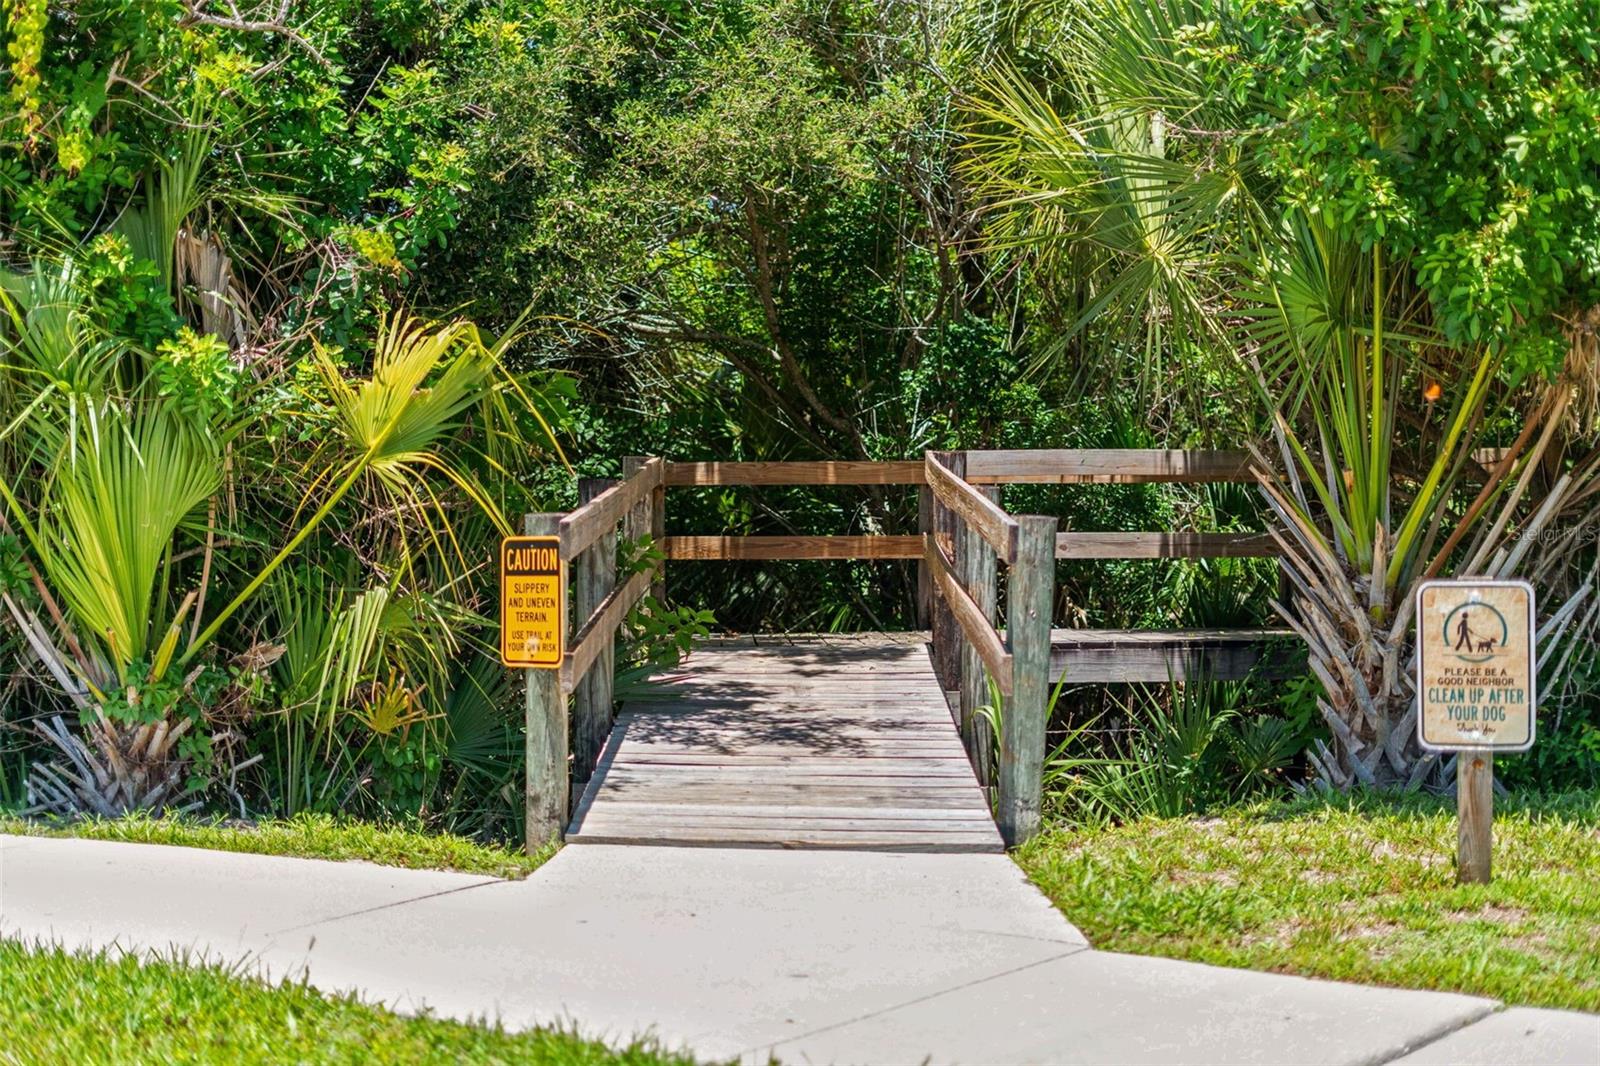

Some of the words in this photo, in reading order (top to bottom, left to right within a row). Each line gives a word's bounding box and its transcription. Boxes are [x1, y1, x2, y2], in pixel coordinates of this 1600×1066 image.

[507, 548, 558, 571] CAUTION
[514, 583, 550, 594] SLIPPERY
[508, 597, 524, 608] AND
[526, 597, 556, 608] UNEVEN
[512, 631, 524, 640] USE
[526, 631, 543, 640] TRAIL
[545, 631, 552, 640] AT
[508, 643, 525, 651] YOUR
[542, 643, 556, 652] RISK
[1444, 668, 1481, 676] PLEASE
[1485, 668, 1497, 676] BE
[1500, 668, 1507, 676] A
[1437, 677, 1463, 686] GOOD
[1466, 677, 1515, 686] NEIGHBOR
[1428, 688, 1465, 703] CLEAN
[1469, 688, 1484, 703] UP
[1489, 688, 1524, 703] AFTER
[1447, 706, 1478, 721] YOUR
[1483, 706, 1506, 721] DOG
[1457, 723, 1479, 732] Thank
[1481, 724, 1496, 736] You
